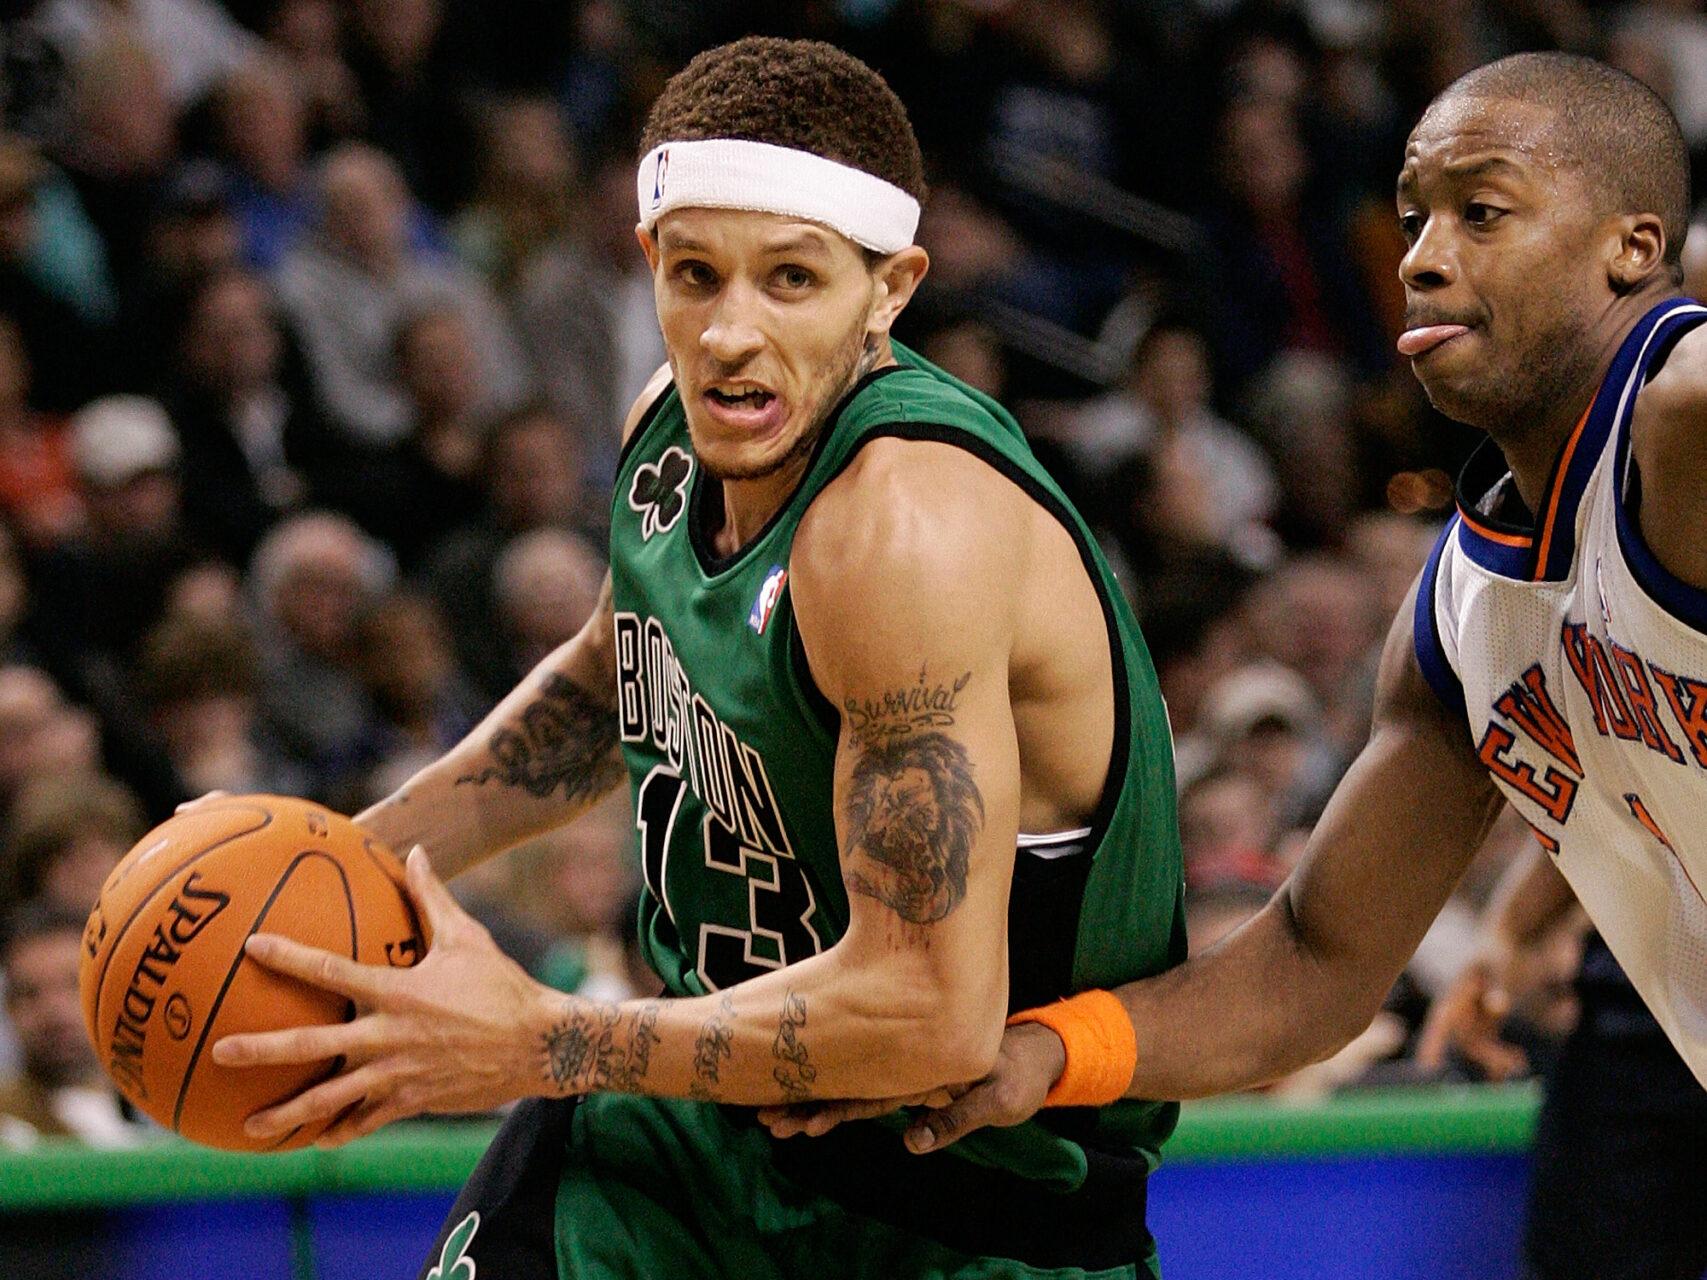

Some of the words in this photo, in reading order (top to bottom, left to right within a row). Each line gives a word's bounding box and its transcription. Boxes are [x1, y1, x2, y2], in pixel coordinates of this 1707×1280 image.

[614, 612, 795, 860] BOSTON
[1475, 660, 1585, 855] EW
[636, 764, 821, 992] 13
